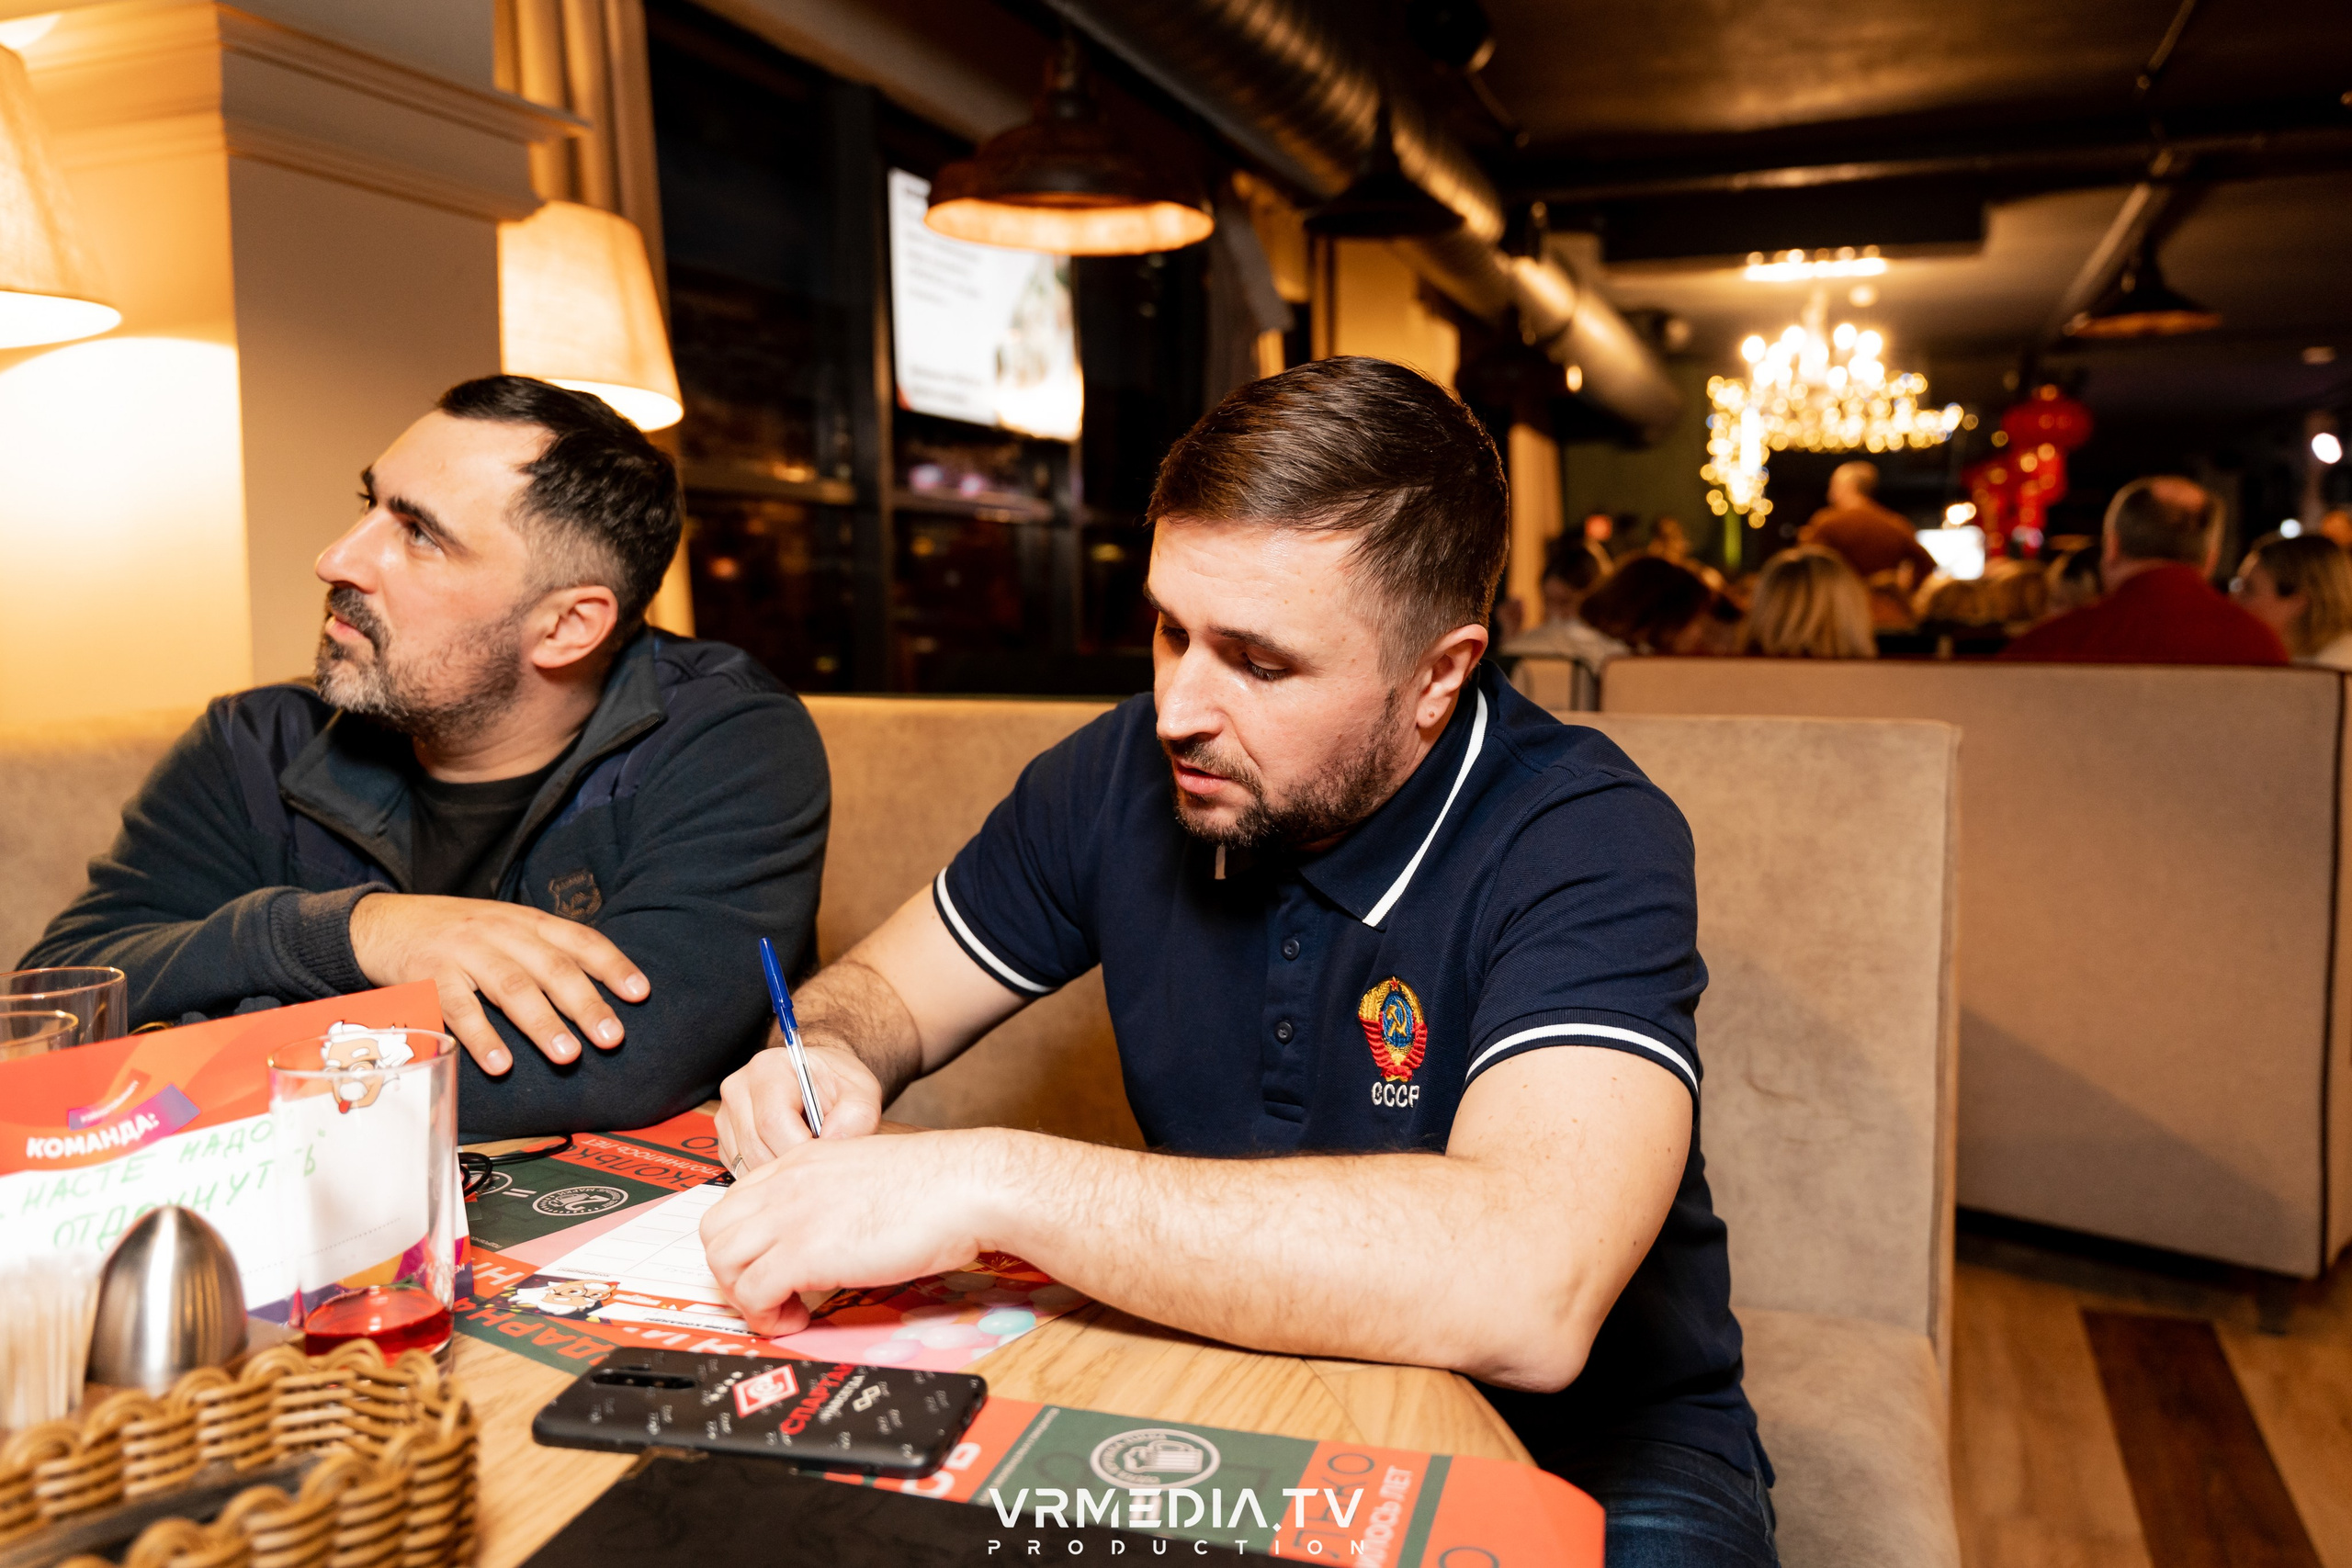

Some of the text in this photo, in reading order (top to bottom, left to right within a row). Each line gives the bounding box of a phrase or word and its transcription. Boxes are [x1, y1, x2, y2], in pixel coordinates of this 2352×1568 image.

[1371, 1080, 1420, 1109] СССР
[27, 1112, 159, 1159] КОМАНДА:
[581, 1138, 615, 1152] ЛЕТ
[453, 1297, 616, 1367] ДАРНА
